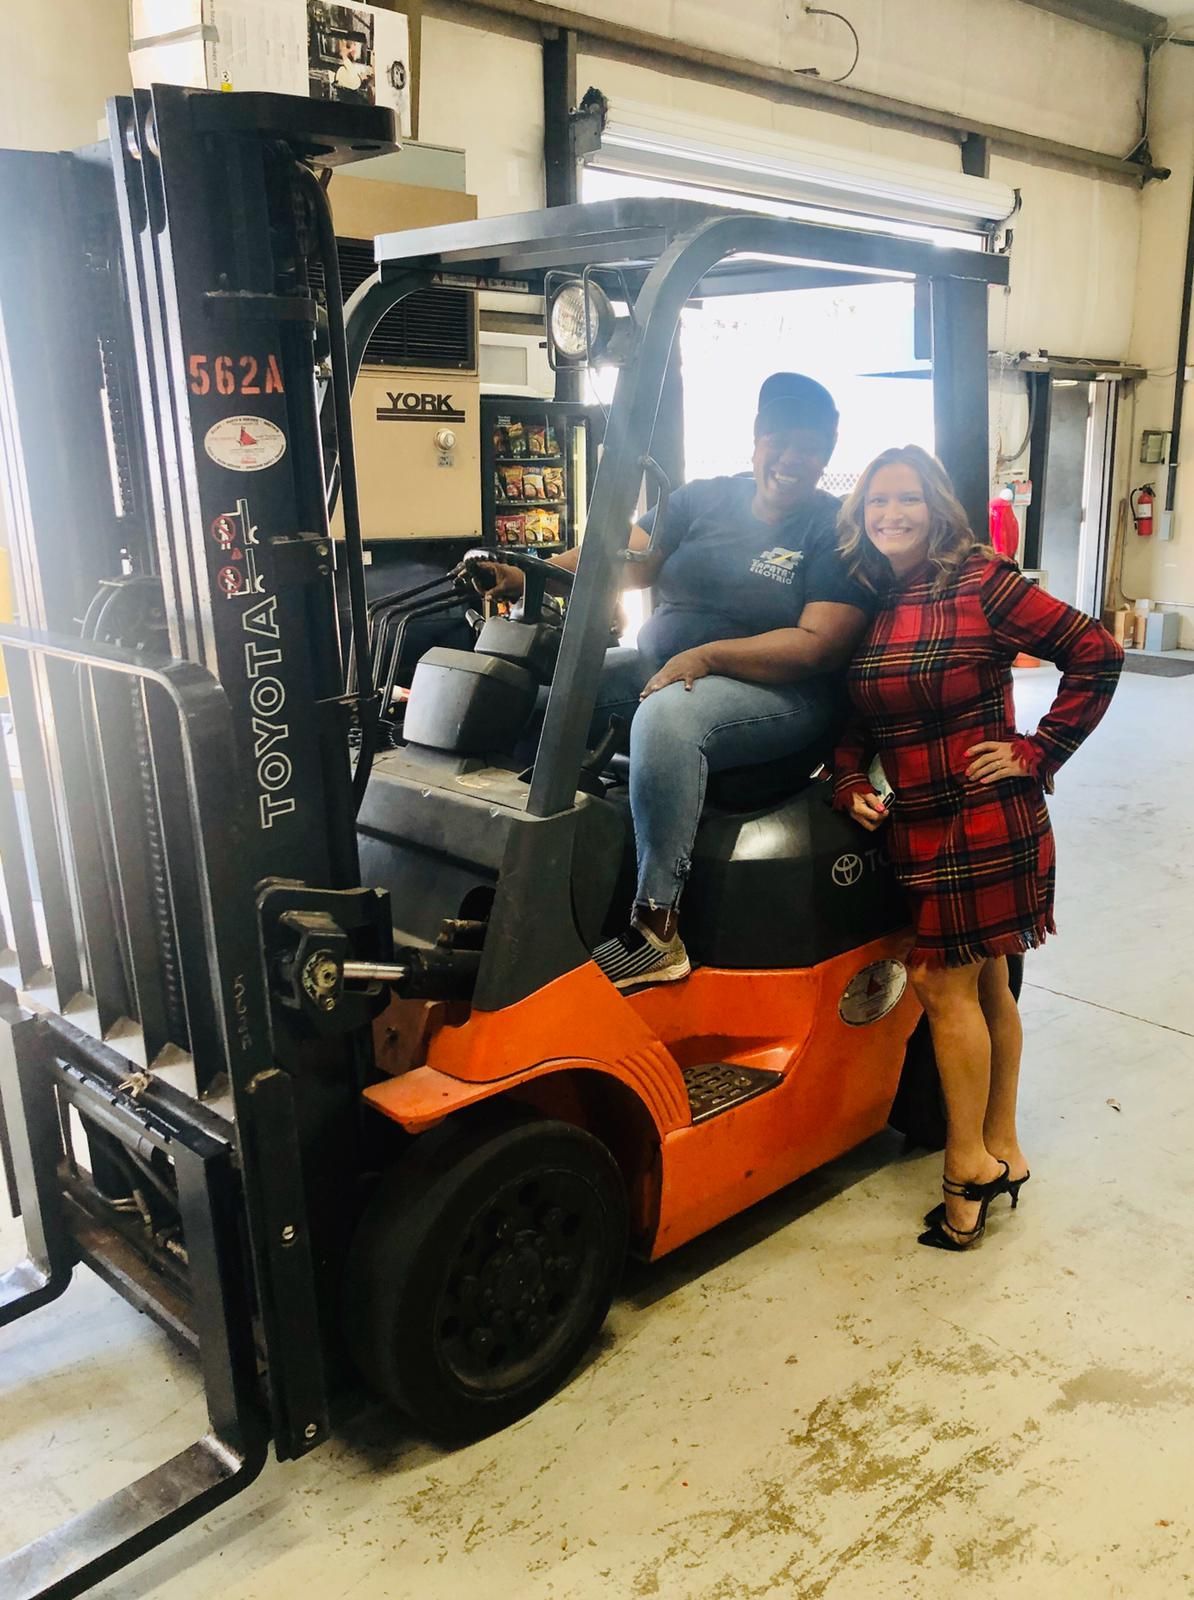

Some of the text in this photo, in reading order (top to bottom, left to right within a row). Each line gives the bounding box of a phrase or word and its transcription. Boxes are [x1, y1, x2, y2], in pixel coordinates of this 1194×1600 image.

[189, 354, 284, 395] 562A
[386, 392, 454, 411] YORK
[242, 595, 296, 829] TOYOTA
